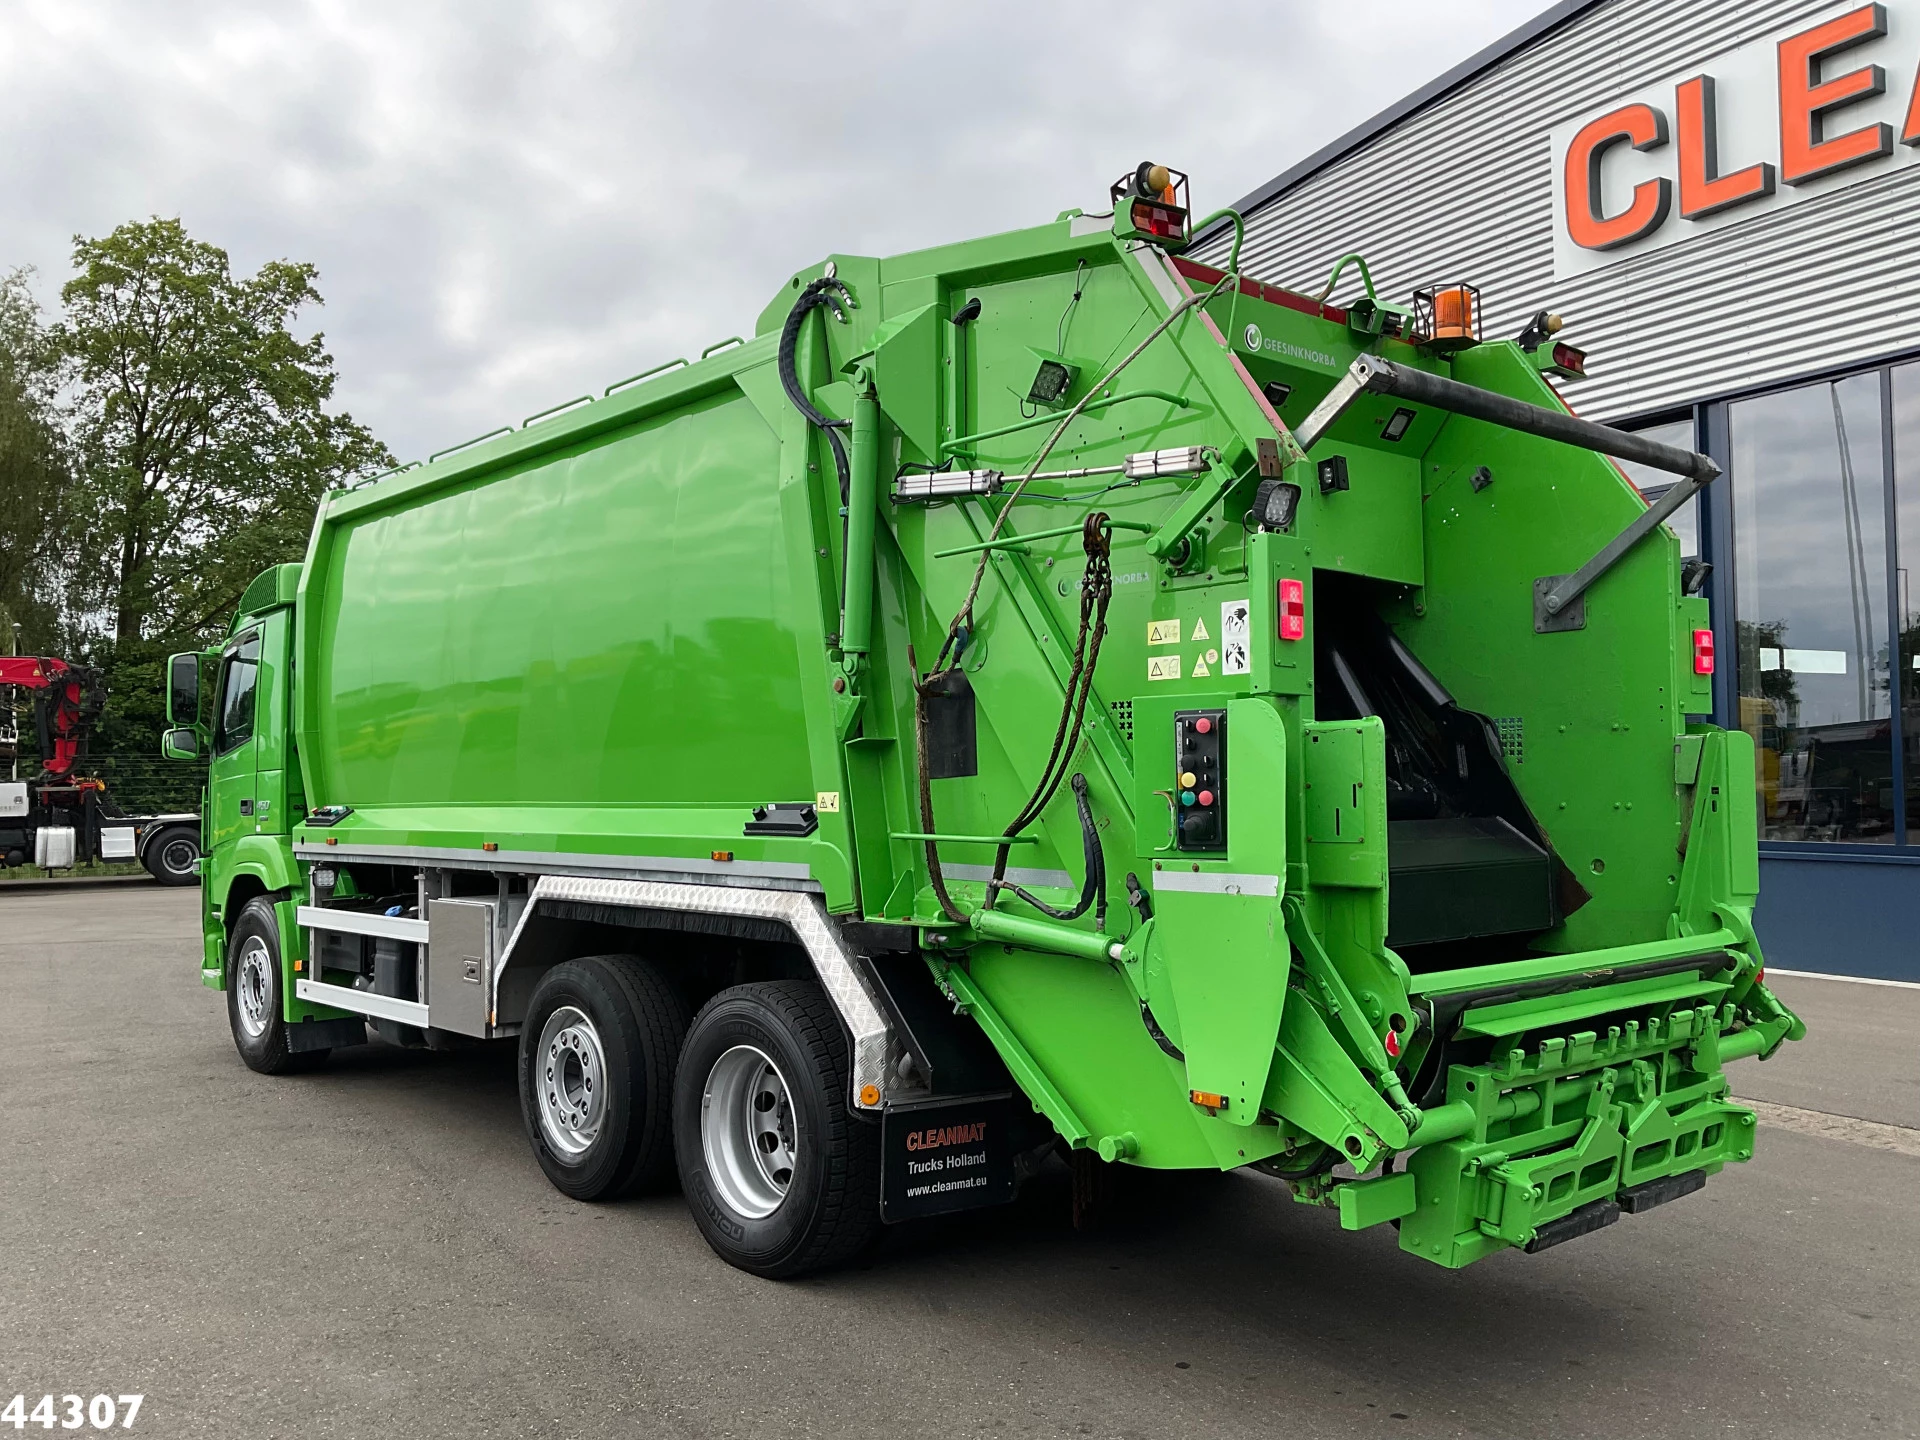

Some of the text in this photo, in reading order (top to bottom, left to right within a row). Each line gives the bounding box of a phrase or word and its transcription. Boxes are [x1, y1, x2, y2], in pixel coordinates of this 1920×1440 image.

[1564, 2, 1920, 251] CLE
[1264, 338, 1336, 367] GEESINKNORBA
[907, 1122, 986, 1151] CLEANMAT
[908, 1151, 986, 1175] Trucks Holland
[907, 1177, 987, 1197] www.cleanmat.eu
